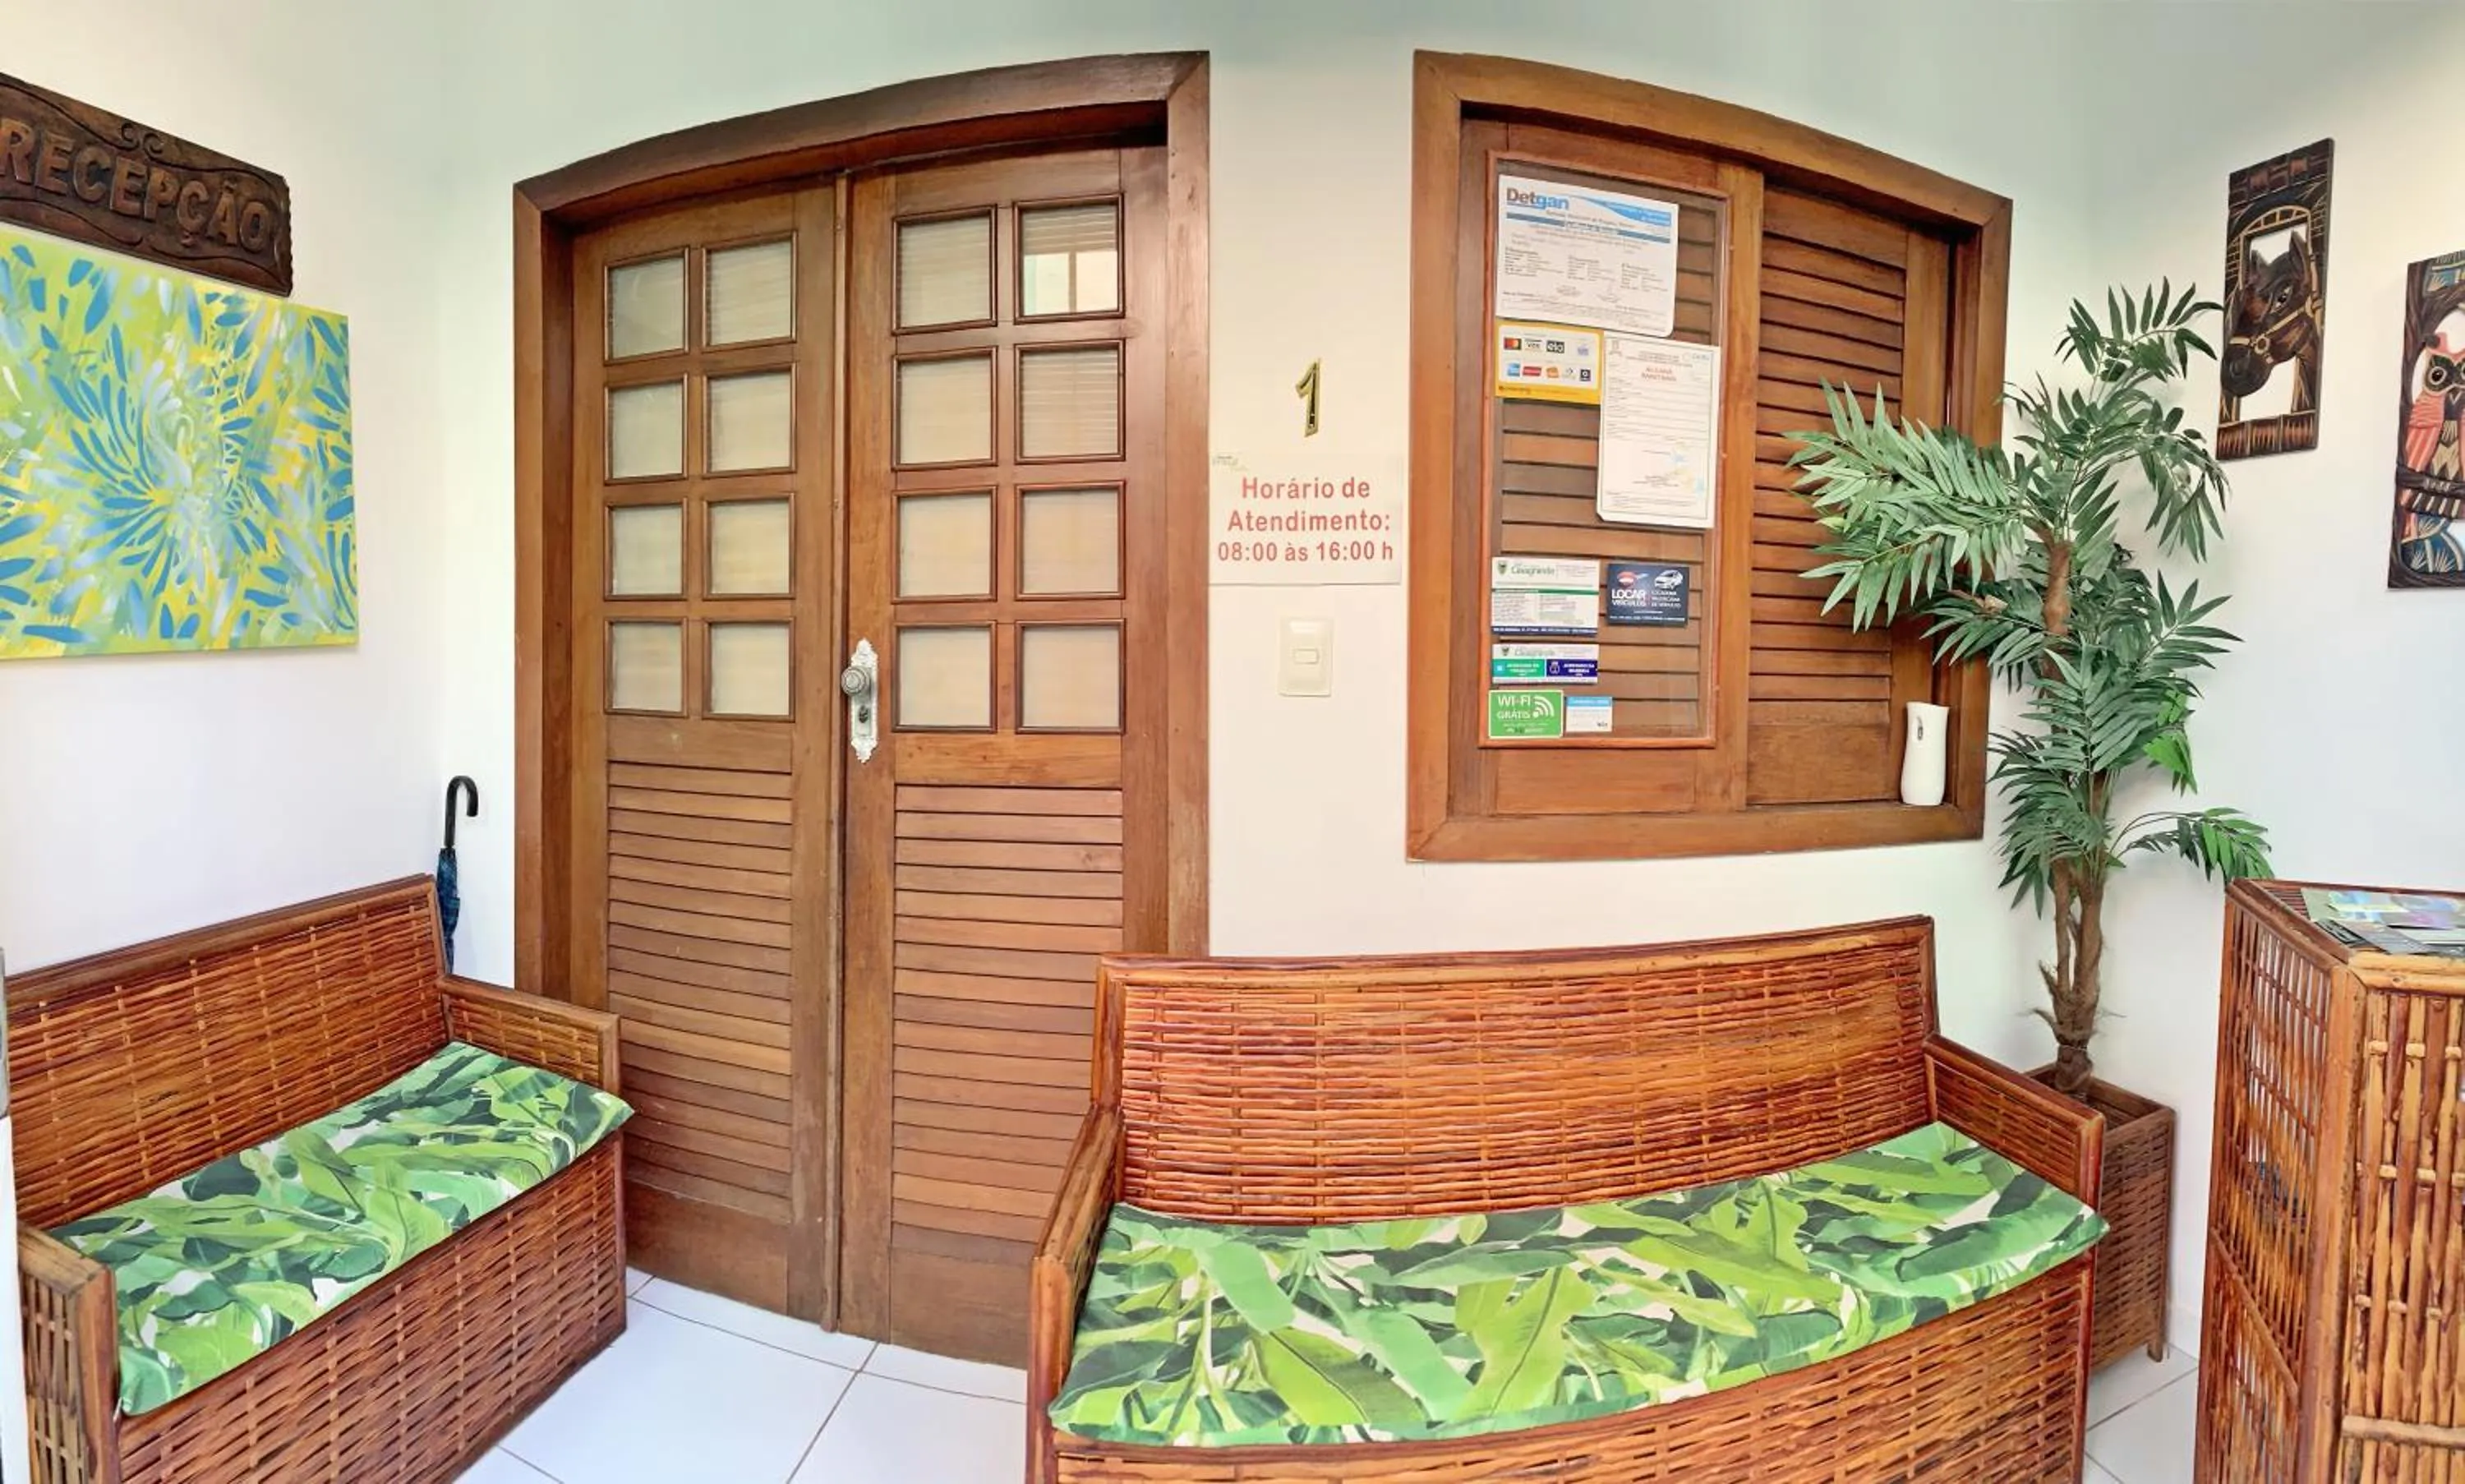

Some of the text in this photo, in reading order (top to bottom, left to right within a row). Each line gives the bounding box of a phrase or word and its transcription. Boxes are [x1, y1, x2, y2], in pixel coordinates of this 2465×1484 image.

[0, 118, 272, 254] RECEPÇÃO
[1506, 187, 1569, 210] Detgan
[1295, 357, 1320, 438] 1
[1242, 477, 1371, 500] Horário de
[1228, 509, 1390, 532] Atendimento:
[1218, 541, 1393, 562] 08:00 às 16:00 h
[1611, 588, 1646, 600] LOCAR
